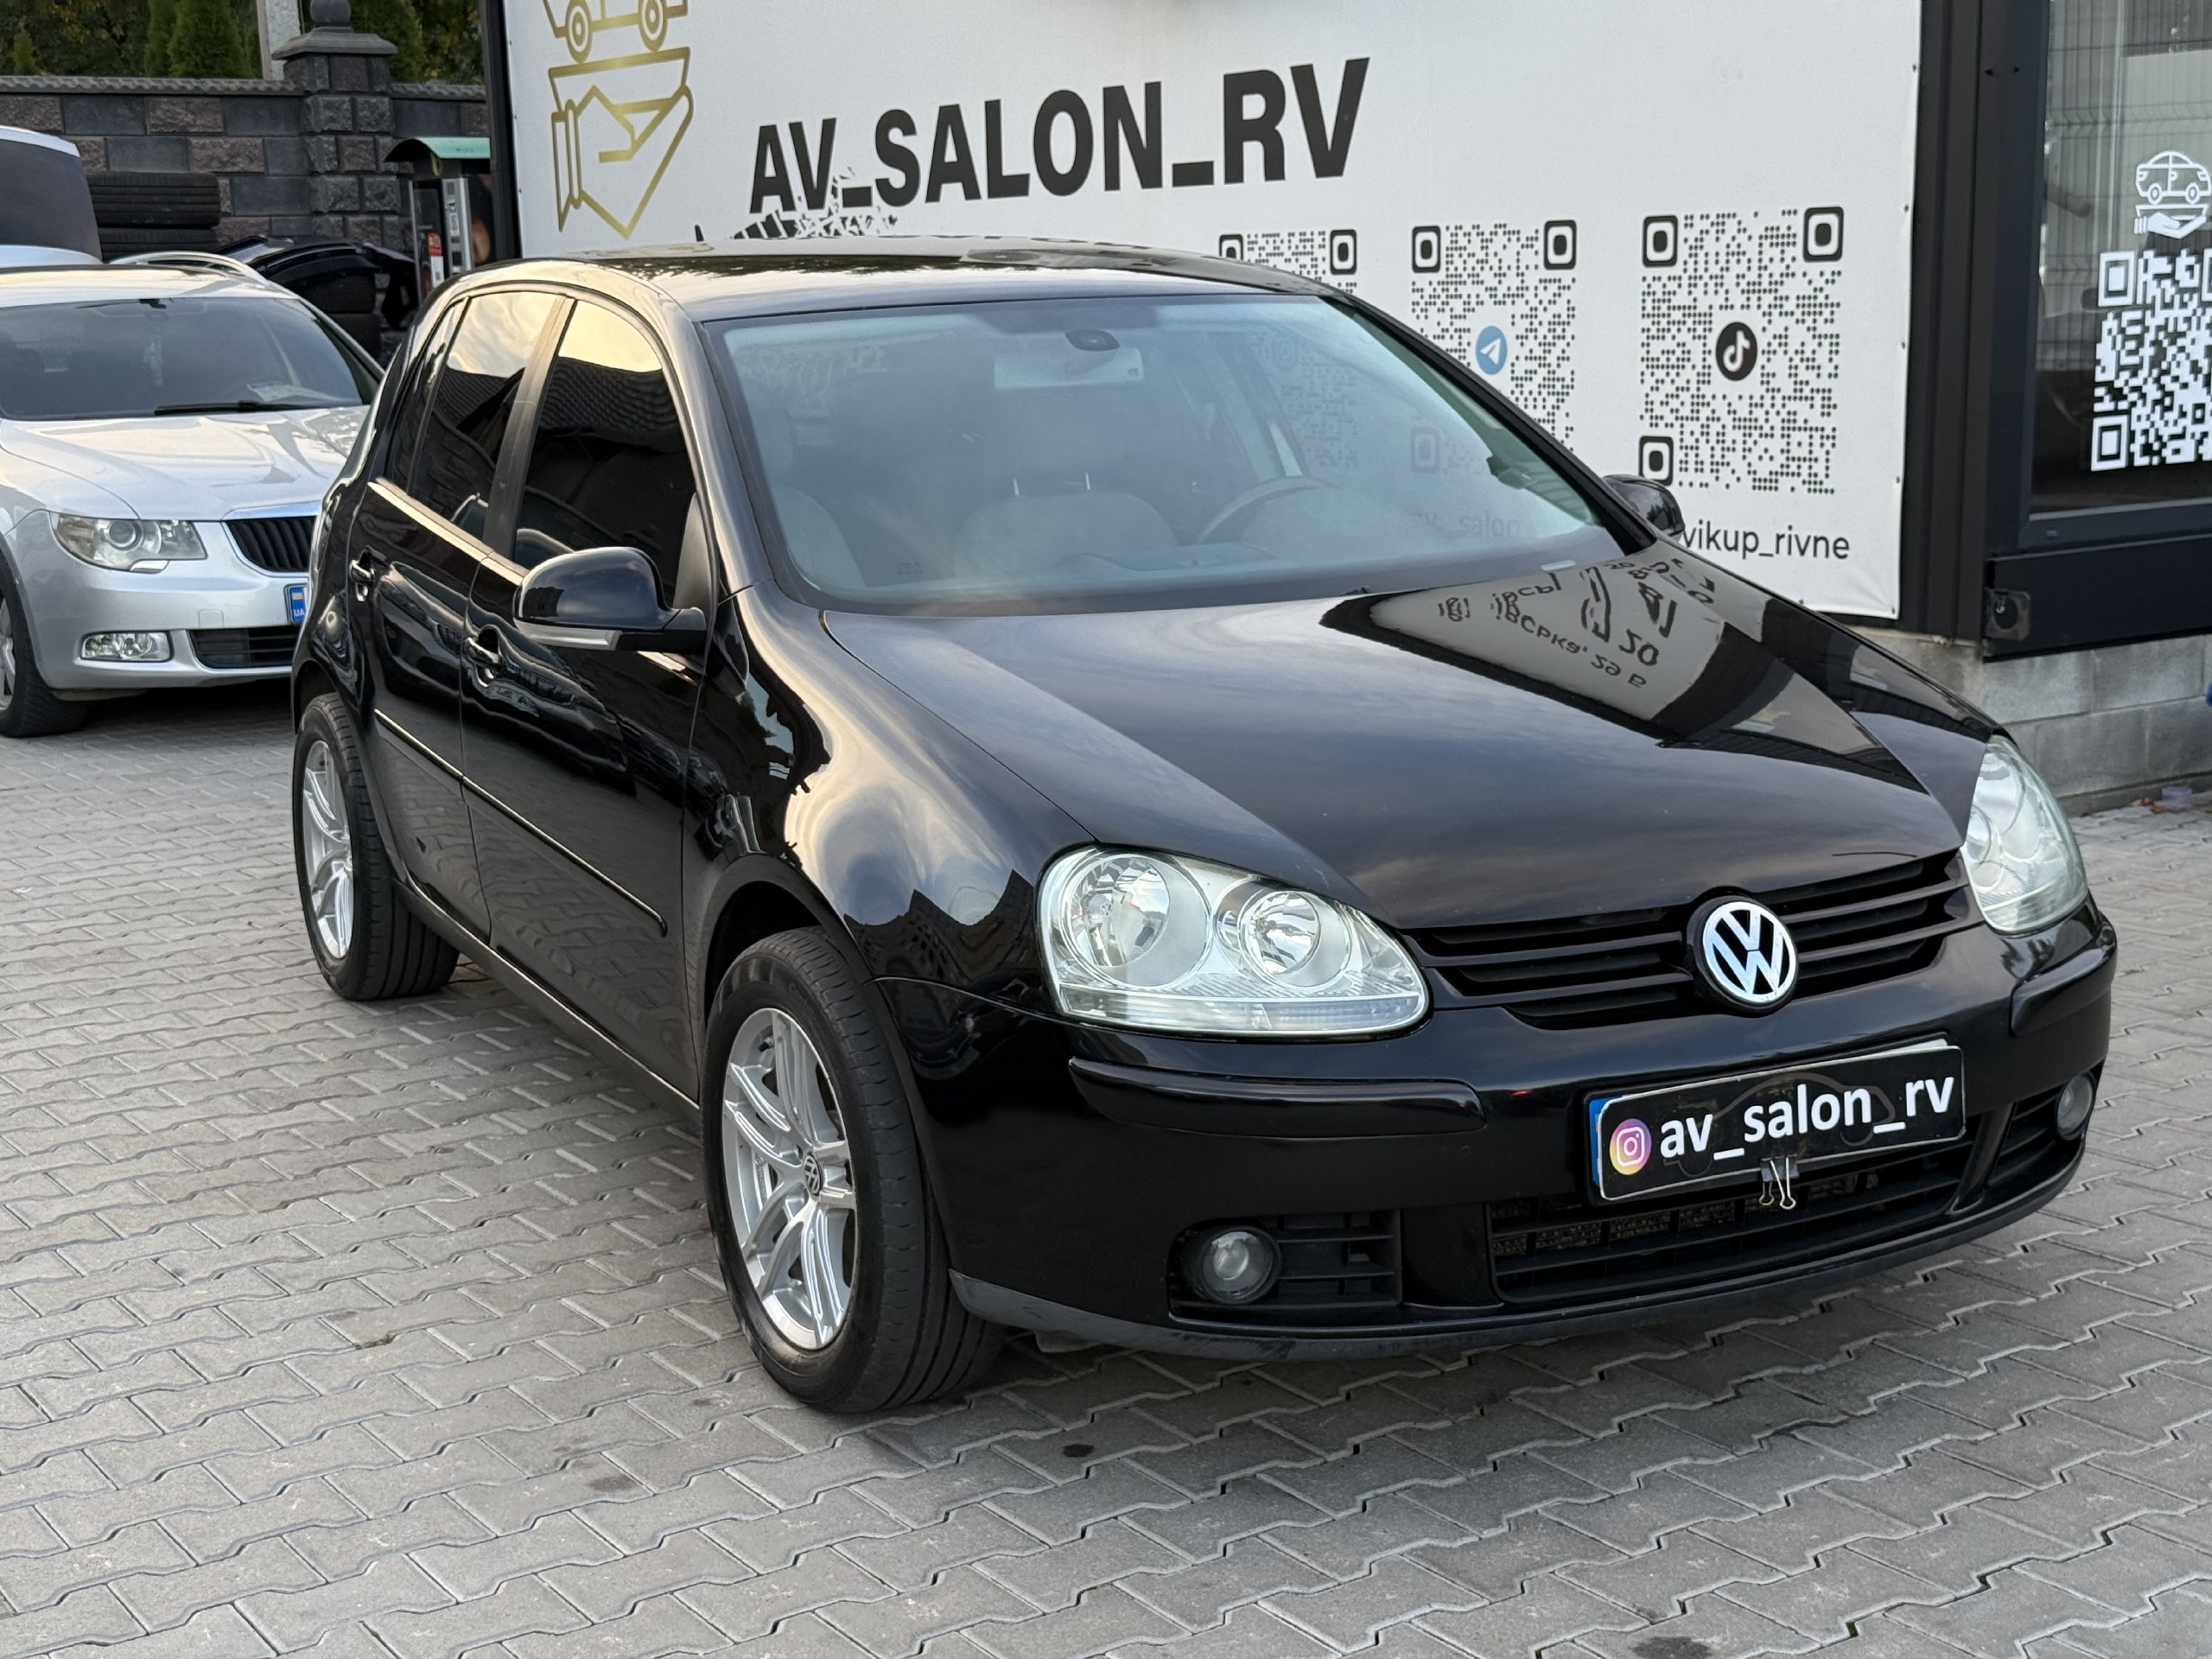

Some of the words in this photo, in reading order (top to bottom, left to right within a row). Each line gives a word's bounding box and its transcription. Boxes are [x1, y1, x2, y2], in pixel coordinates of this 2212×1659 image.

[749, 57, 1370, 213] AV_SALON_RV
[294, 608, 306, 617] UA
[1660, 1077, 1955, 1160] av_salon_rv
